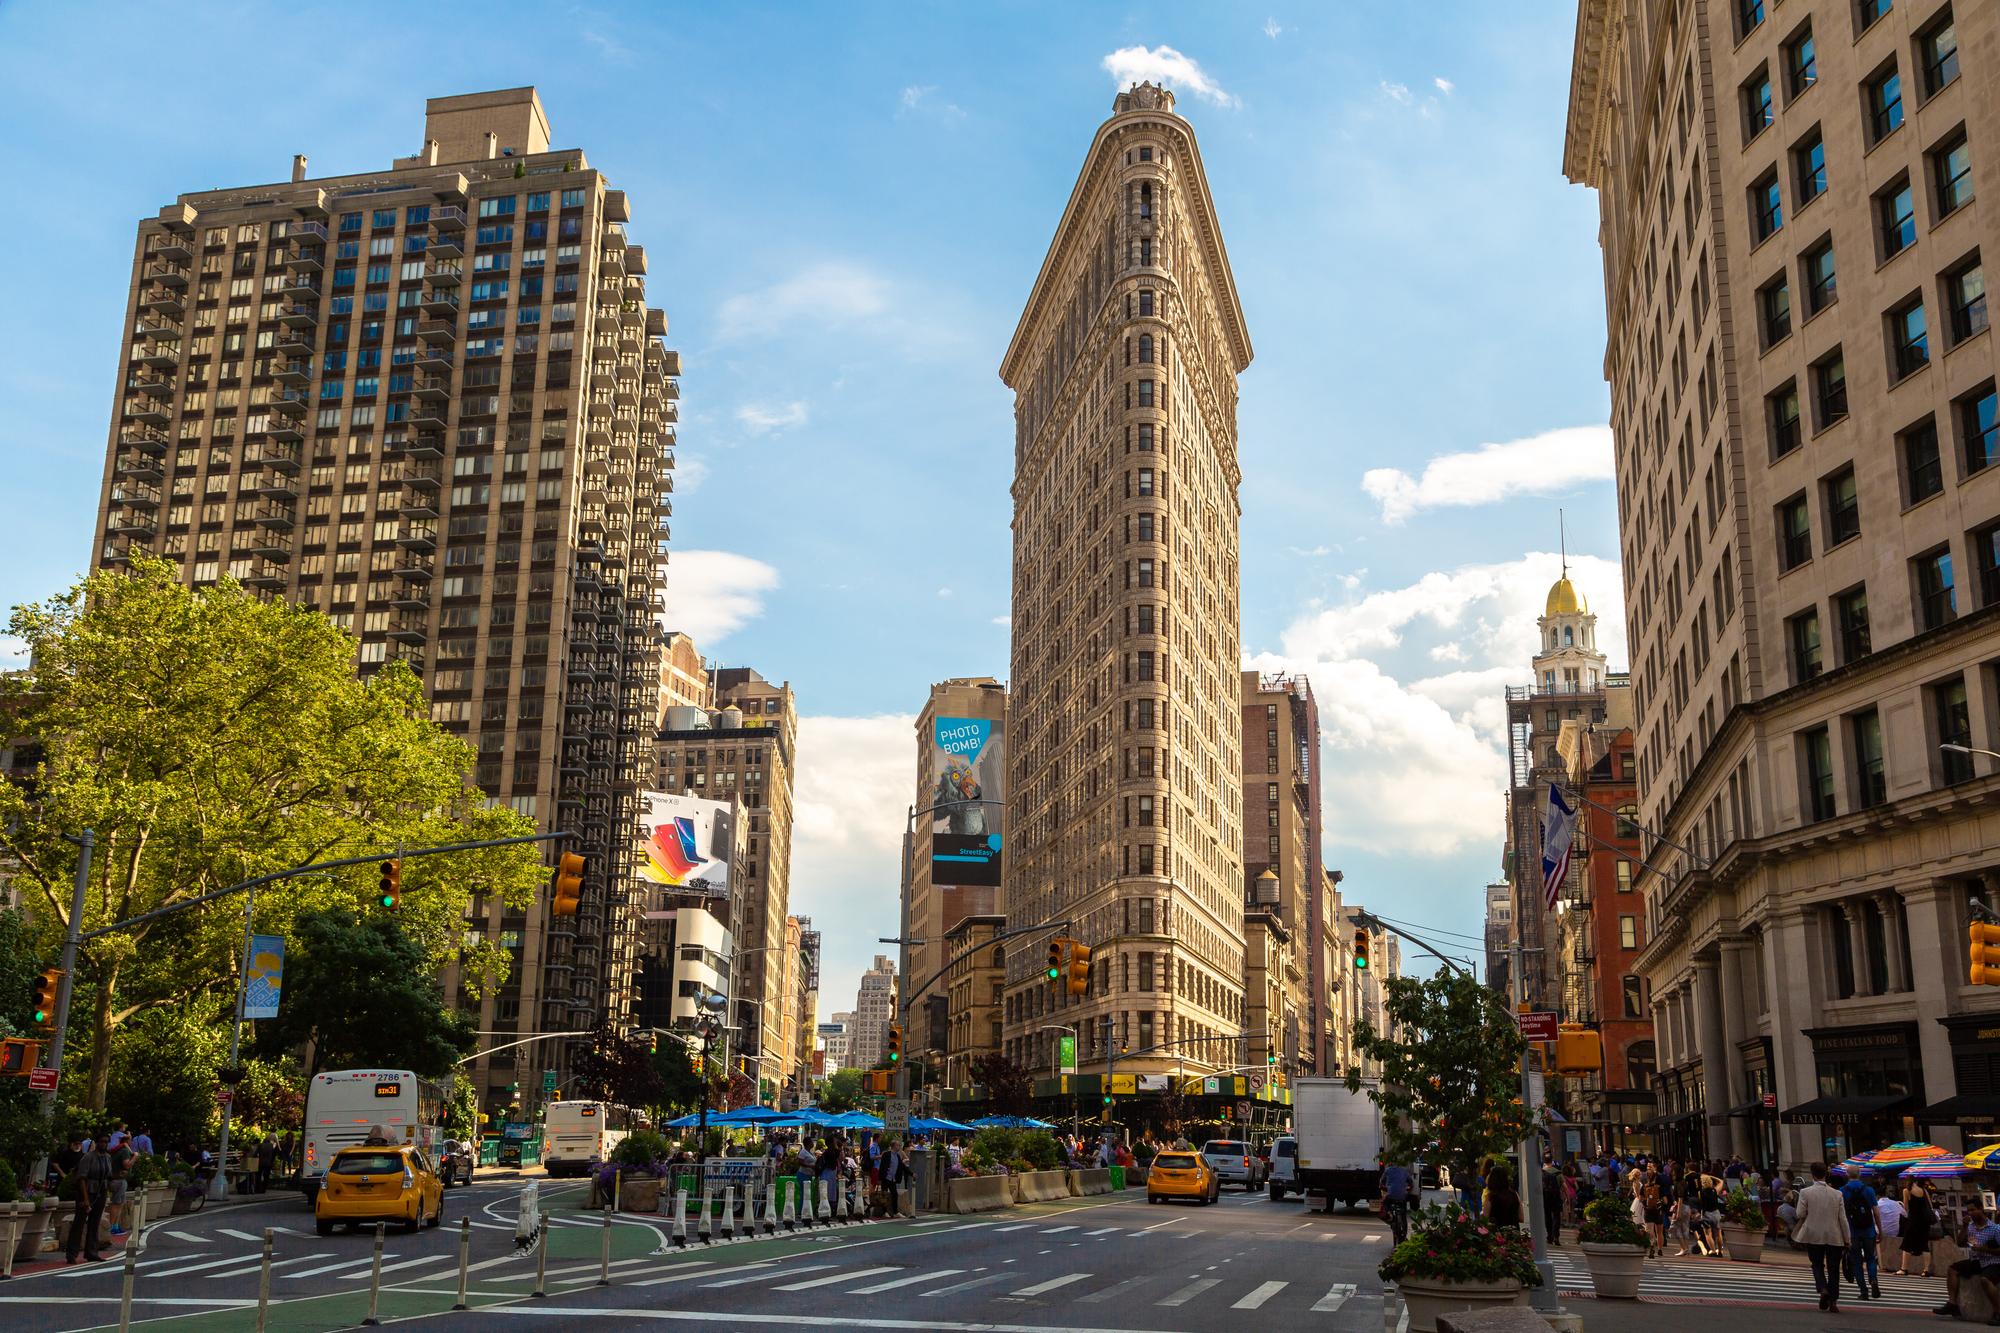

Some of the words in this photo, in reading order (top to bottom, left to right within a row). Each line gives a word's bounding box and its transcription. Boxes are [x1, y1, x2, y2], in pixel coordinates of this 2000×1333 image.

[941, 725, 979, 742] PHOTO
[944, 738, 982, 755] BOMB!
[960, 848, 993, 857] StreetEasy
[1528, 1014, 1551, 1022] STANDING
[1840, 1035, 1873, 1047] ITALIAN
[1876, 1034, 1898, 1045] FOOD
[1792, 1114, 1825, 1123] EATALY
[1829, 1113, 1860, 1123] CAFFE
